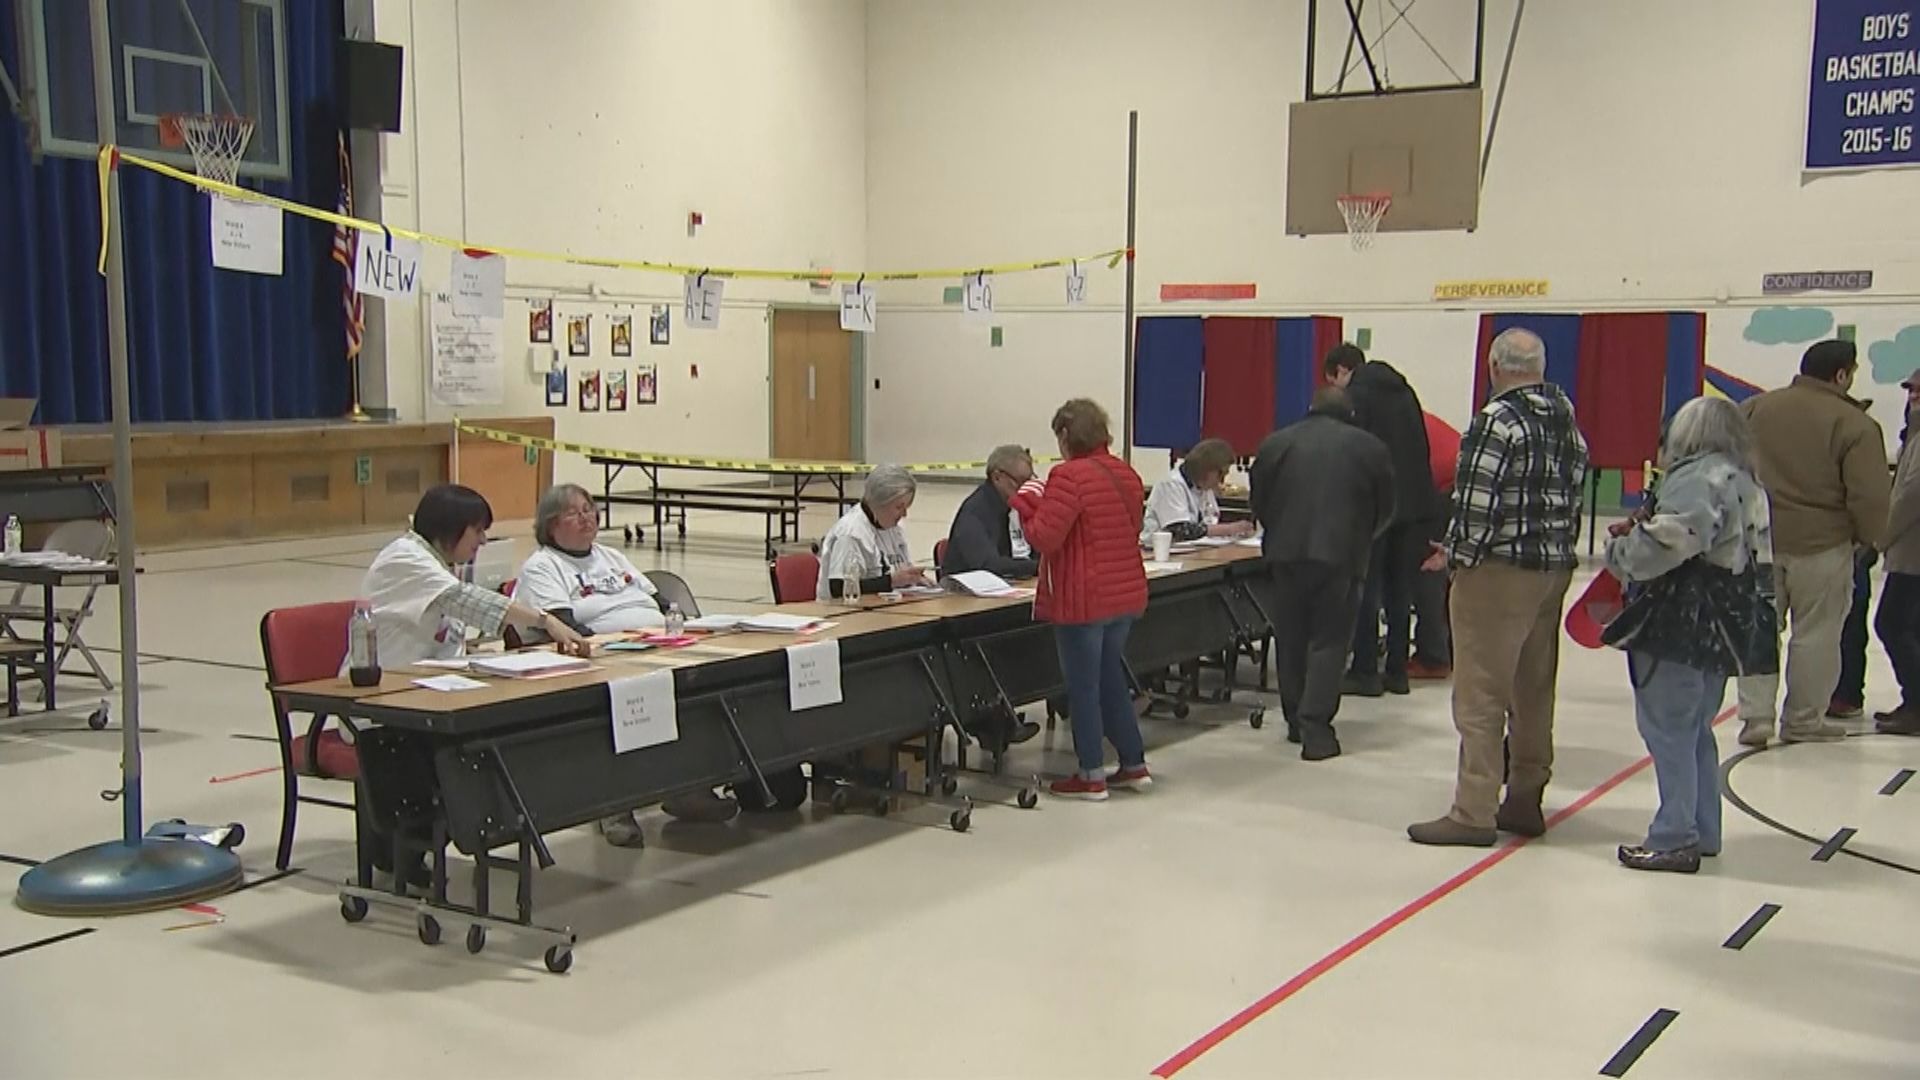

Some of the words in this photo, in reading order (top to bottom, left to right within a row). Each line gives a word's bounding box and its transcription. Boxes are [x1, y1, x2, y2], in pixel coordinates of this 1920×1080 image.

[1862, 13, 1910, 41] BOYS
[1845, 88, 1915, 117] CHAMPS
[1841, 126, 1913, 154] 2015-16
[365, 245, 416, 293] NEW
[1764, 273, 1870, 288] CONFIDENCE
[685, 284, 716, 321] A-E
[966, 283, 992, 312] L-Q
[1066, 276, 1084, 304] R-Z
[1434, 281, 1547, 297] PERSEVERANCE
[844, 290, 872, 324] F-K
